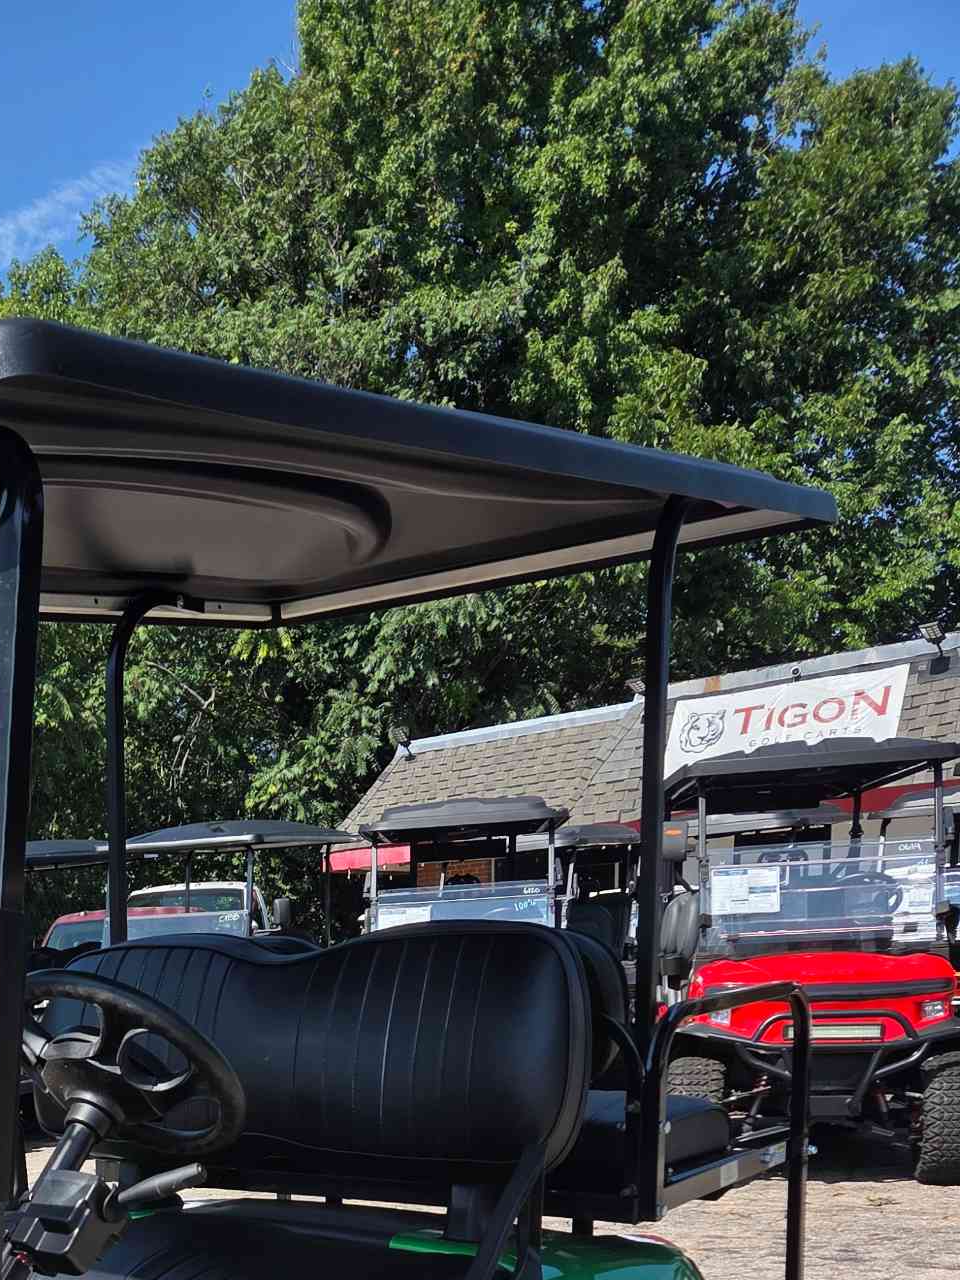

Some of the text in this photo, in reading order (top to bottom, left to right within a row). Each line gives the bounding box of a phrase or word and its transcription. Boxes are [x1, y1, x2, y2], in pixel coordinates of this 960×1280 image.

[734, 685, 892, 735] TIGON
[748, 728, 866, 748] GOLF CARTS
